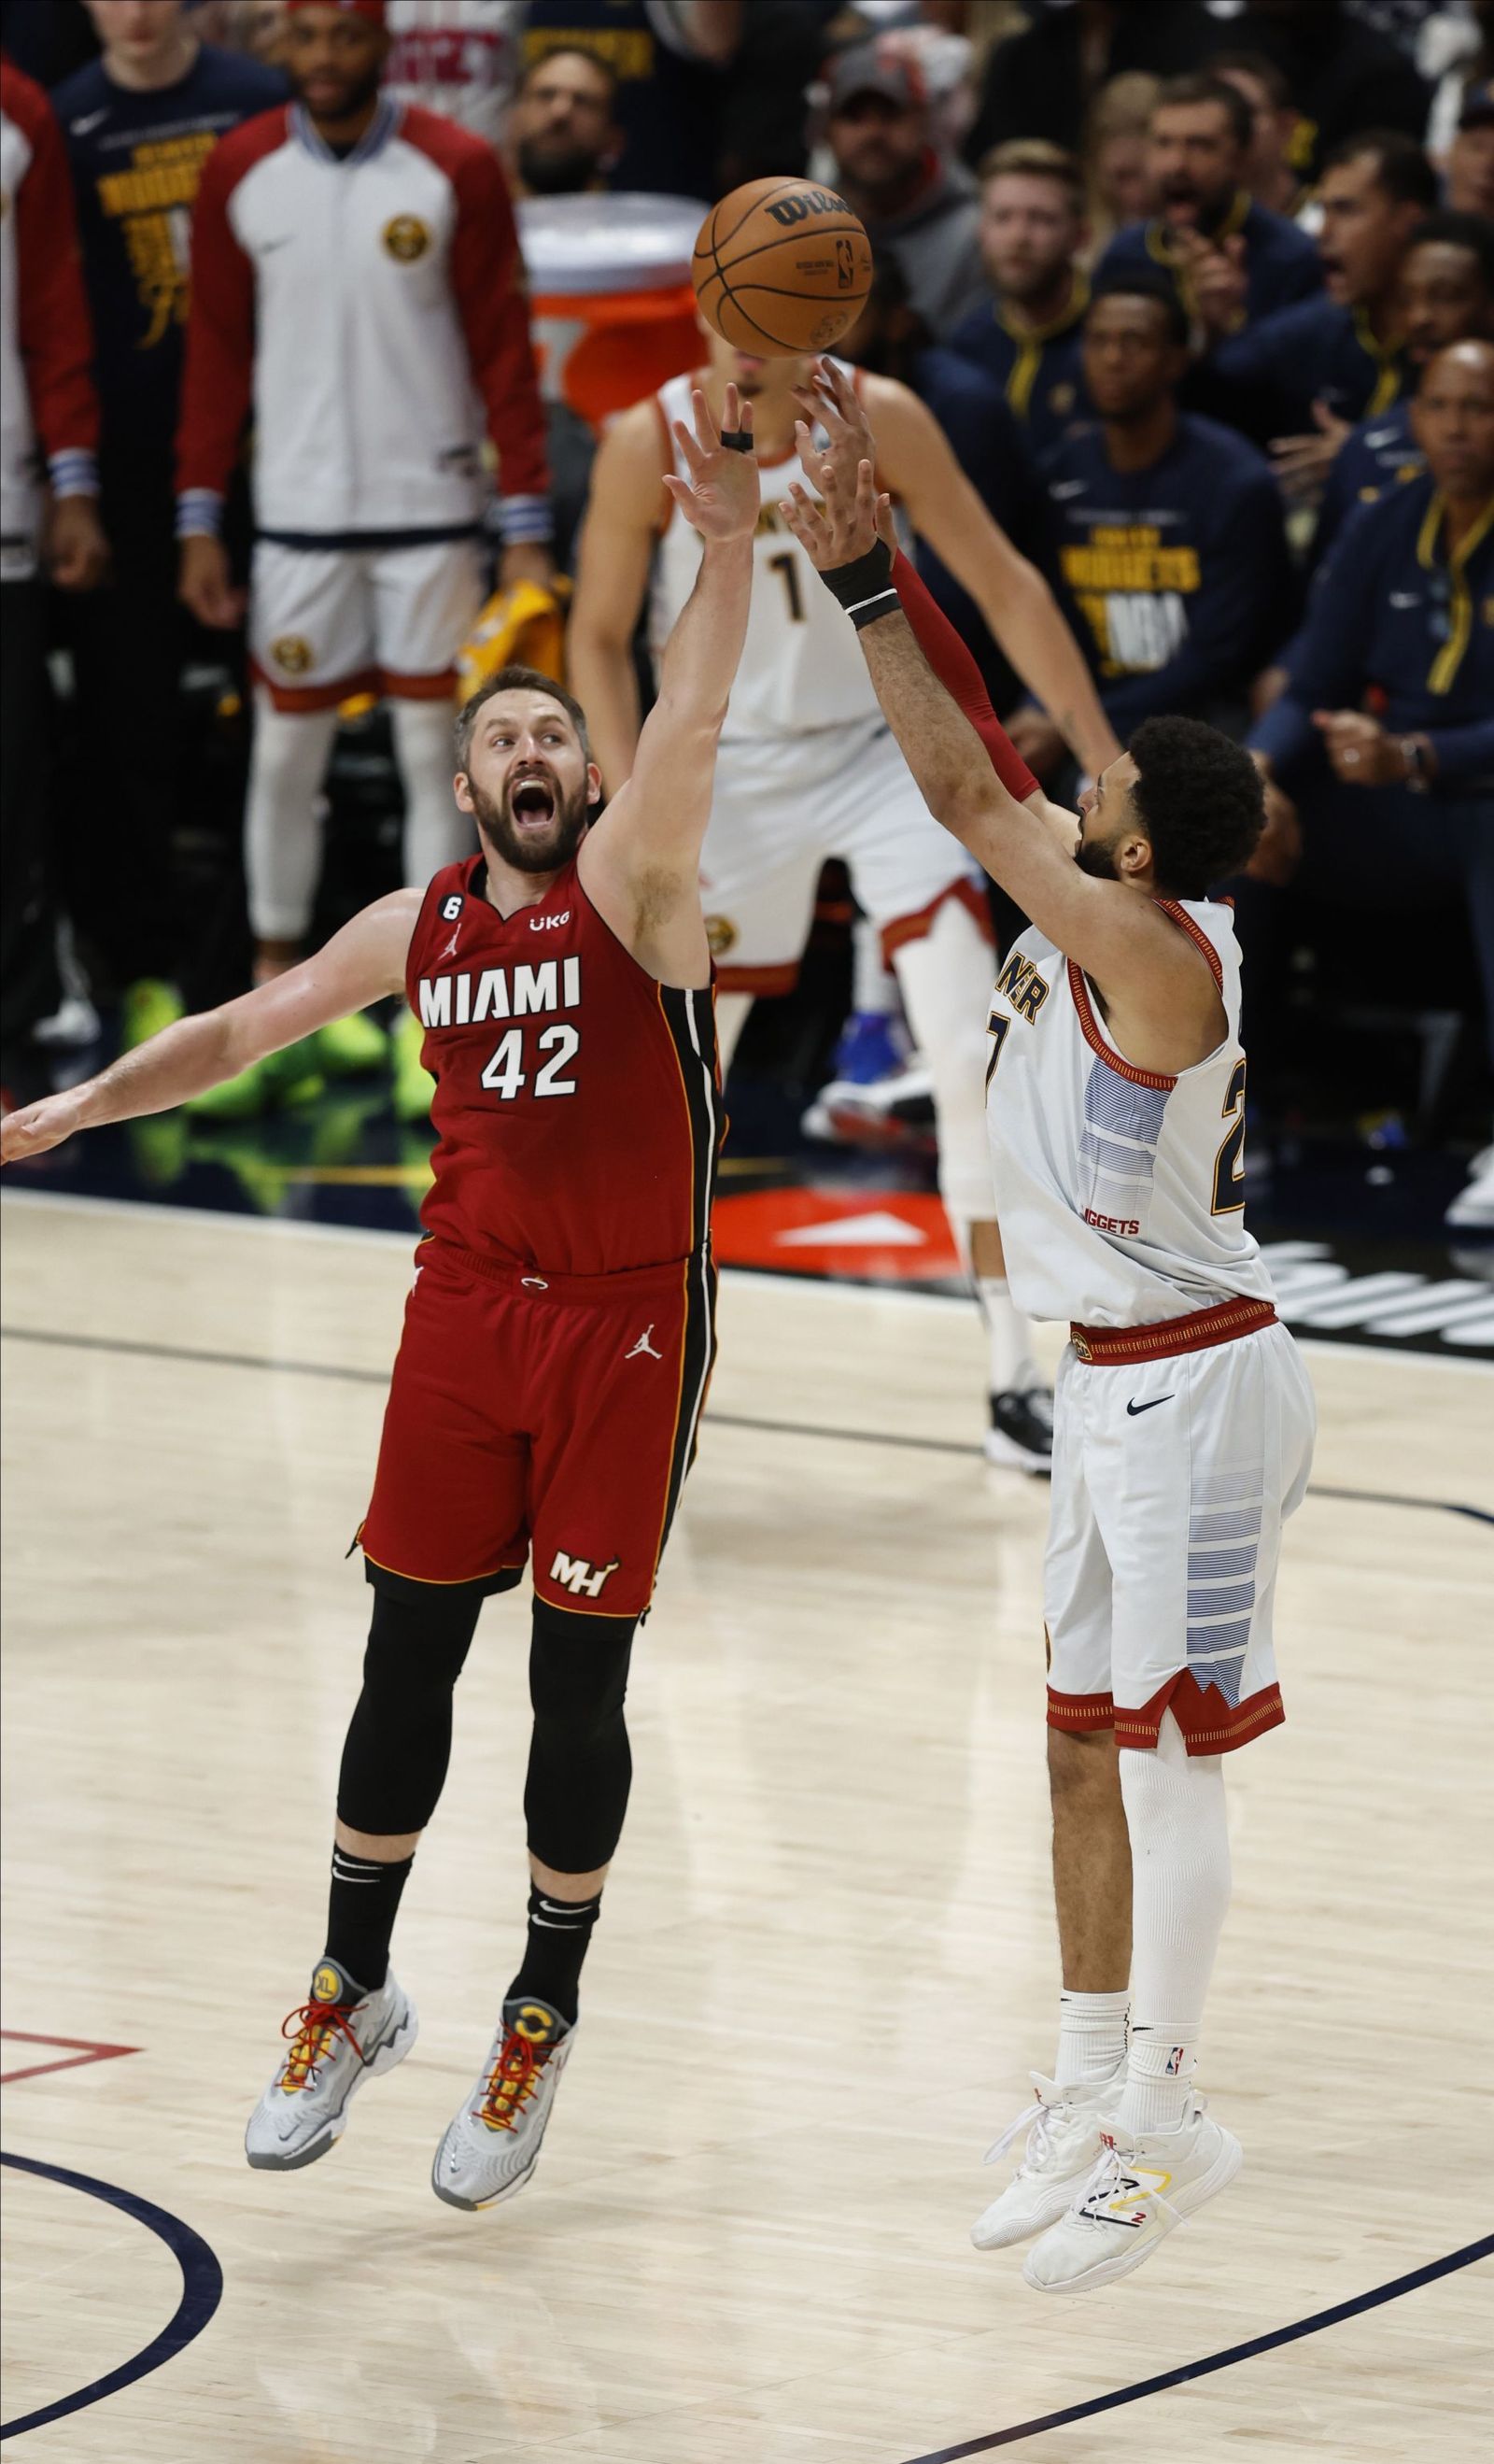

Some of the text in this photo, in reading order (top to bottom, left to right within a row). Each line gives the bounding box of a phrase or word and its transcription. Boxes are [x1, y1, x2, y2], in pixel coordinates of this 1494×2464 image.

[768, 550, 806, 622] 1
[442, 895, 463, 921] 6
[418, 955, 581, 1028] MIAMI
[480, 1024, 580, 1100] 42
[1210, 1057, 1247, 1216] 2
